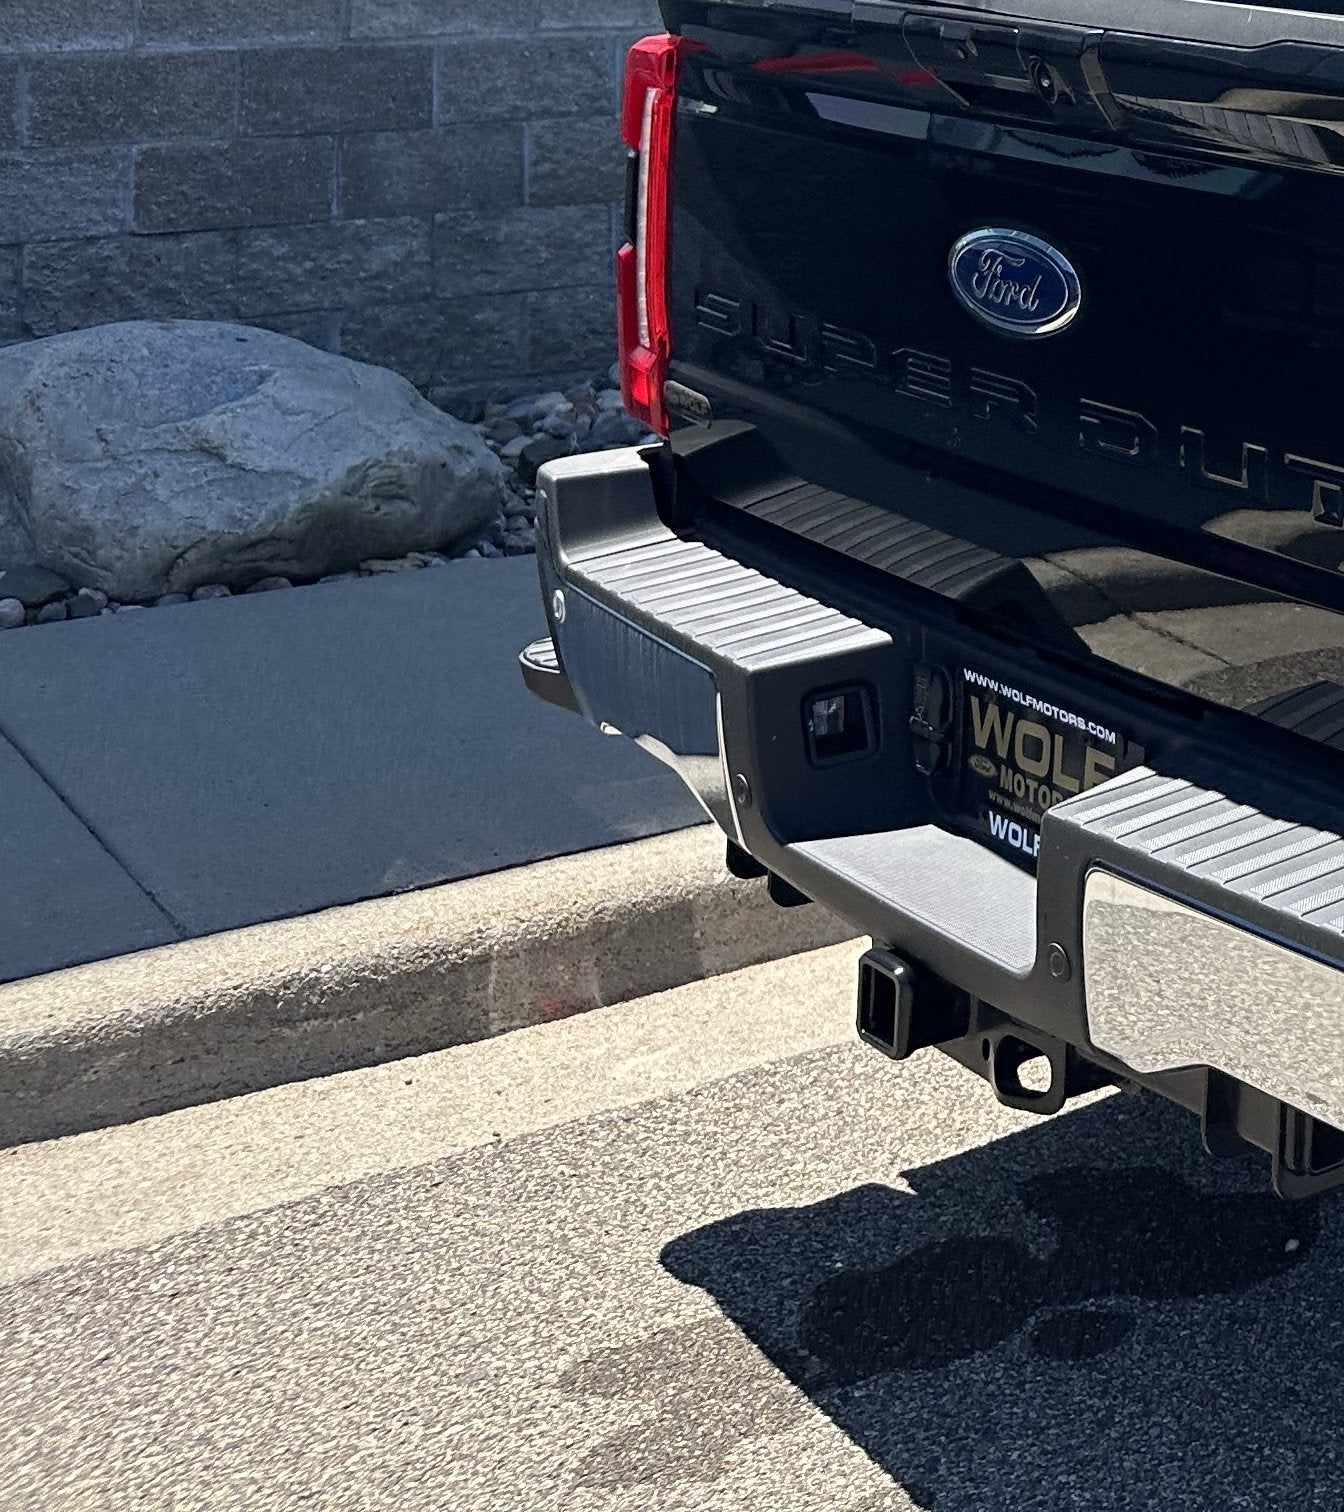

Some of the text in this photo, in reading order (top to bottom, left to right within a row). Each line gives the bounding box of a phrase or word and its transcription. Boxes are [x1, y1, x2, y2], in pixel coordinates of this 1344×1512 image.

[972, 247, 1042, 312] Ford
[695, 290, 1039, 432] SUPER
[963, 667, 1117, 745] WWW.WOLFMOTORS.COM
[970, 695, 1116, 788] WOLF
